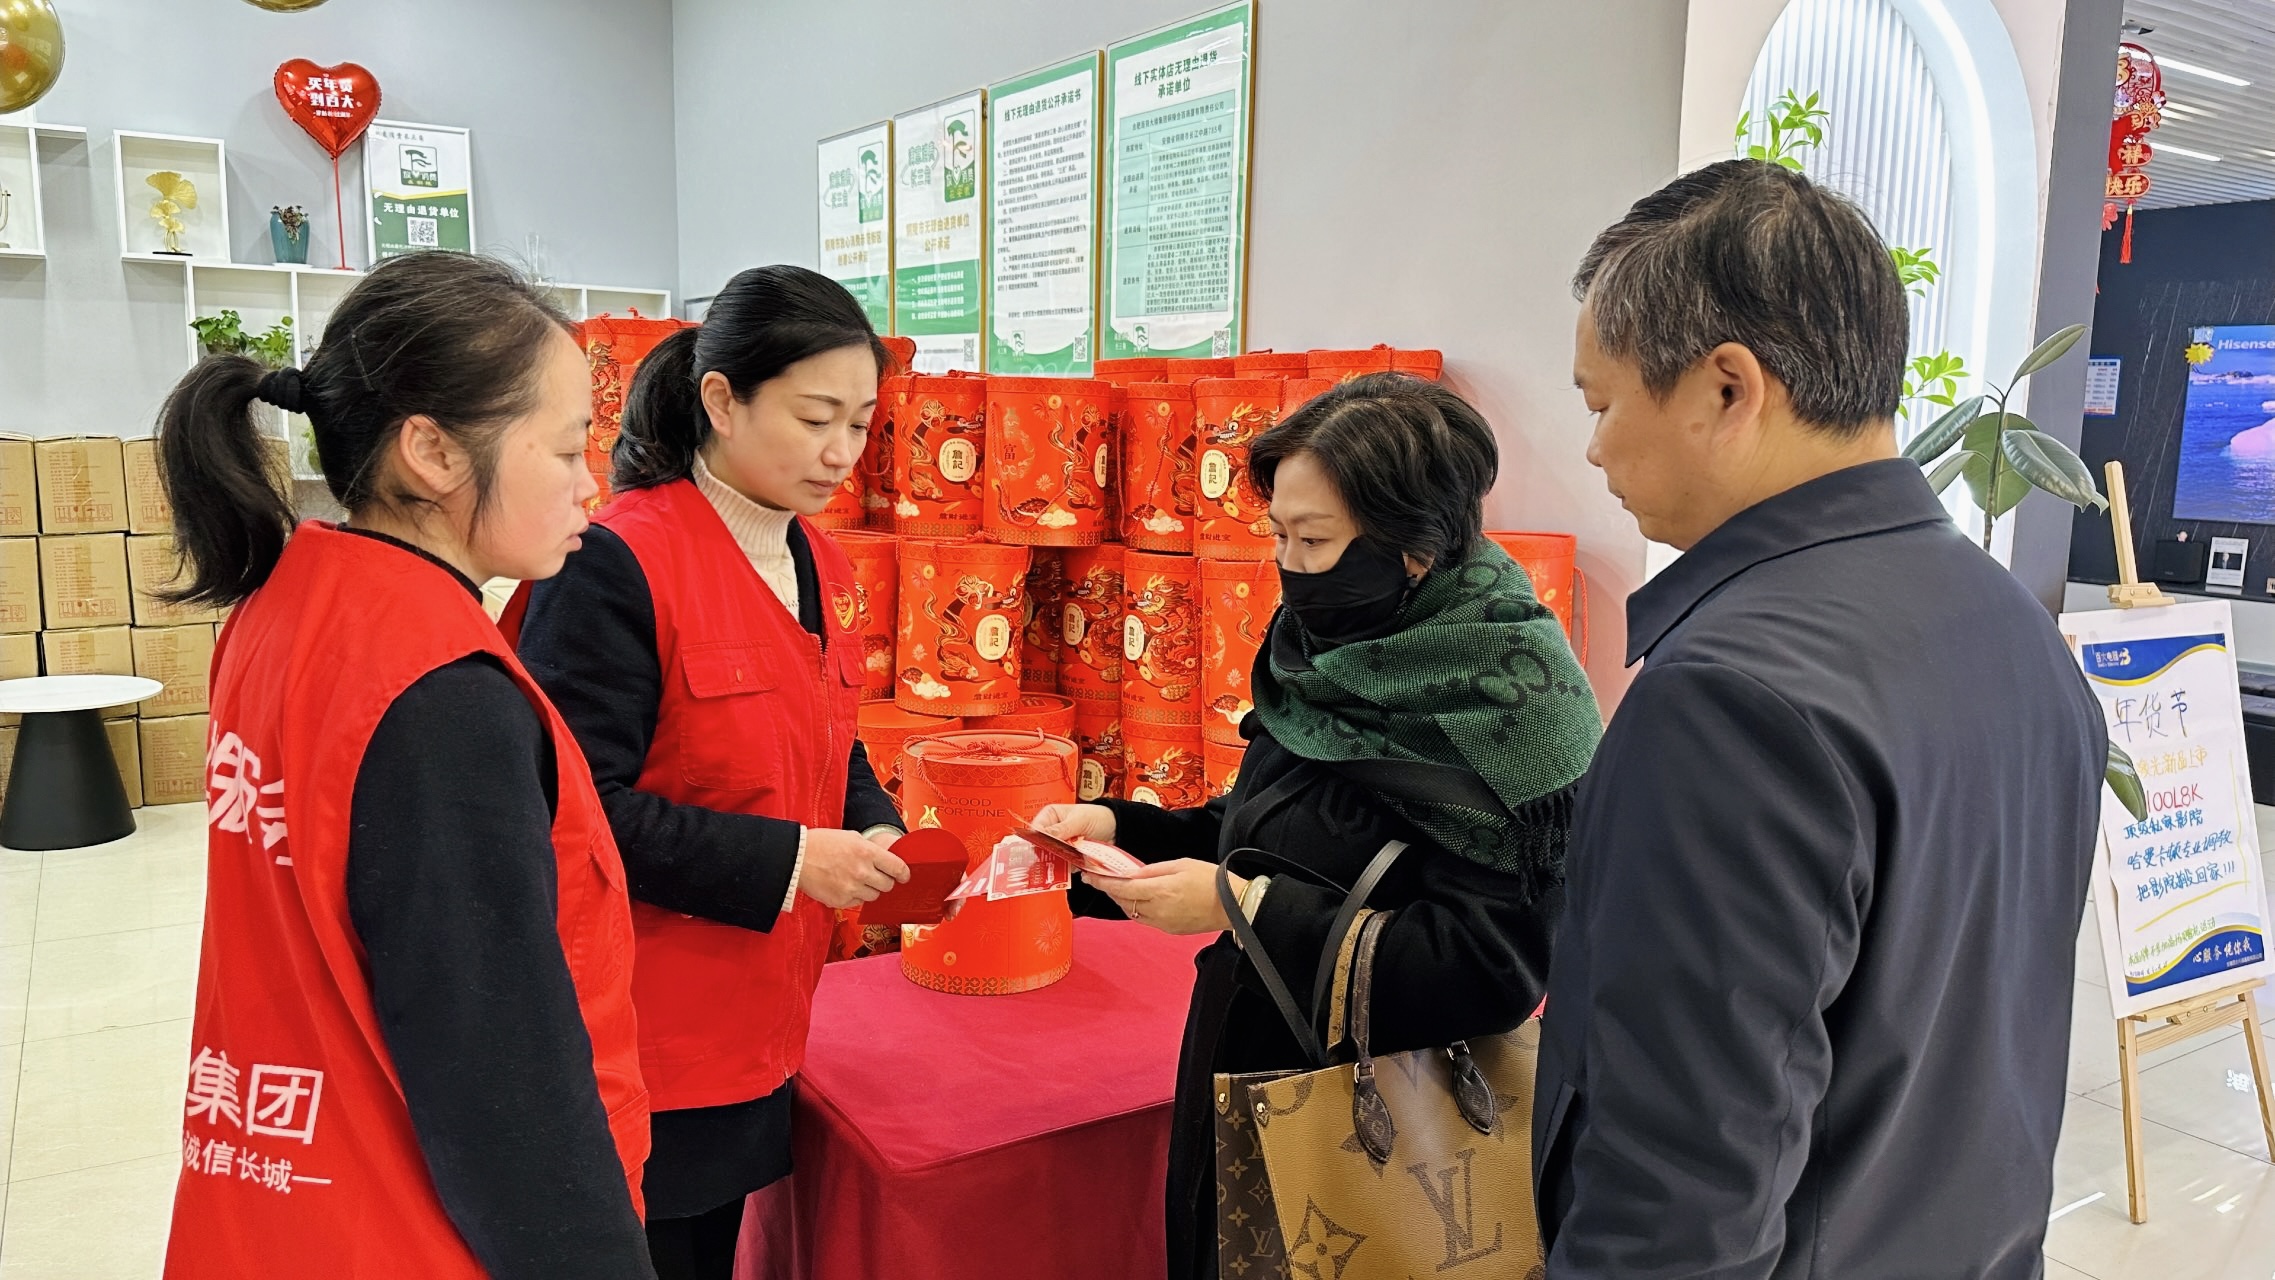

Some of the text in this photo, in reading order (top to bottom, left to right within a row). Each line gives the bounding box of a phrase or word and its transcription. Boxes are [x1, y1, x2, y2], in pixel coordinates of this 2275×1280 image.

[1157, 77, 1191, 99] 承诺单位
[309, 92, 354, 109] 到百大
[1004, 88, 1081, 122] 线下无理由退货公开承诺书
[383, 202, 460, 219] 无理由退货单位
[2218, 339, 2275, 350] Hisense
[2113, 688, 2188, 743] 年货节
[949, 797, 992, 807] GOOD
[2146, 783, 2204, 813] 100L8K
[937, 805, 1006, 818] FORTUNE
[186, 1045, 324, 1145] 集团
